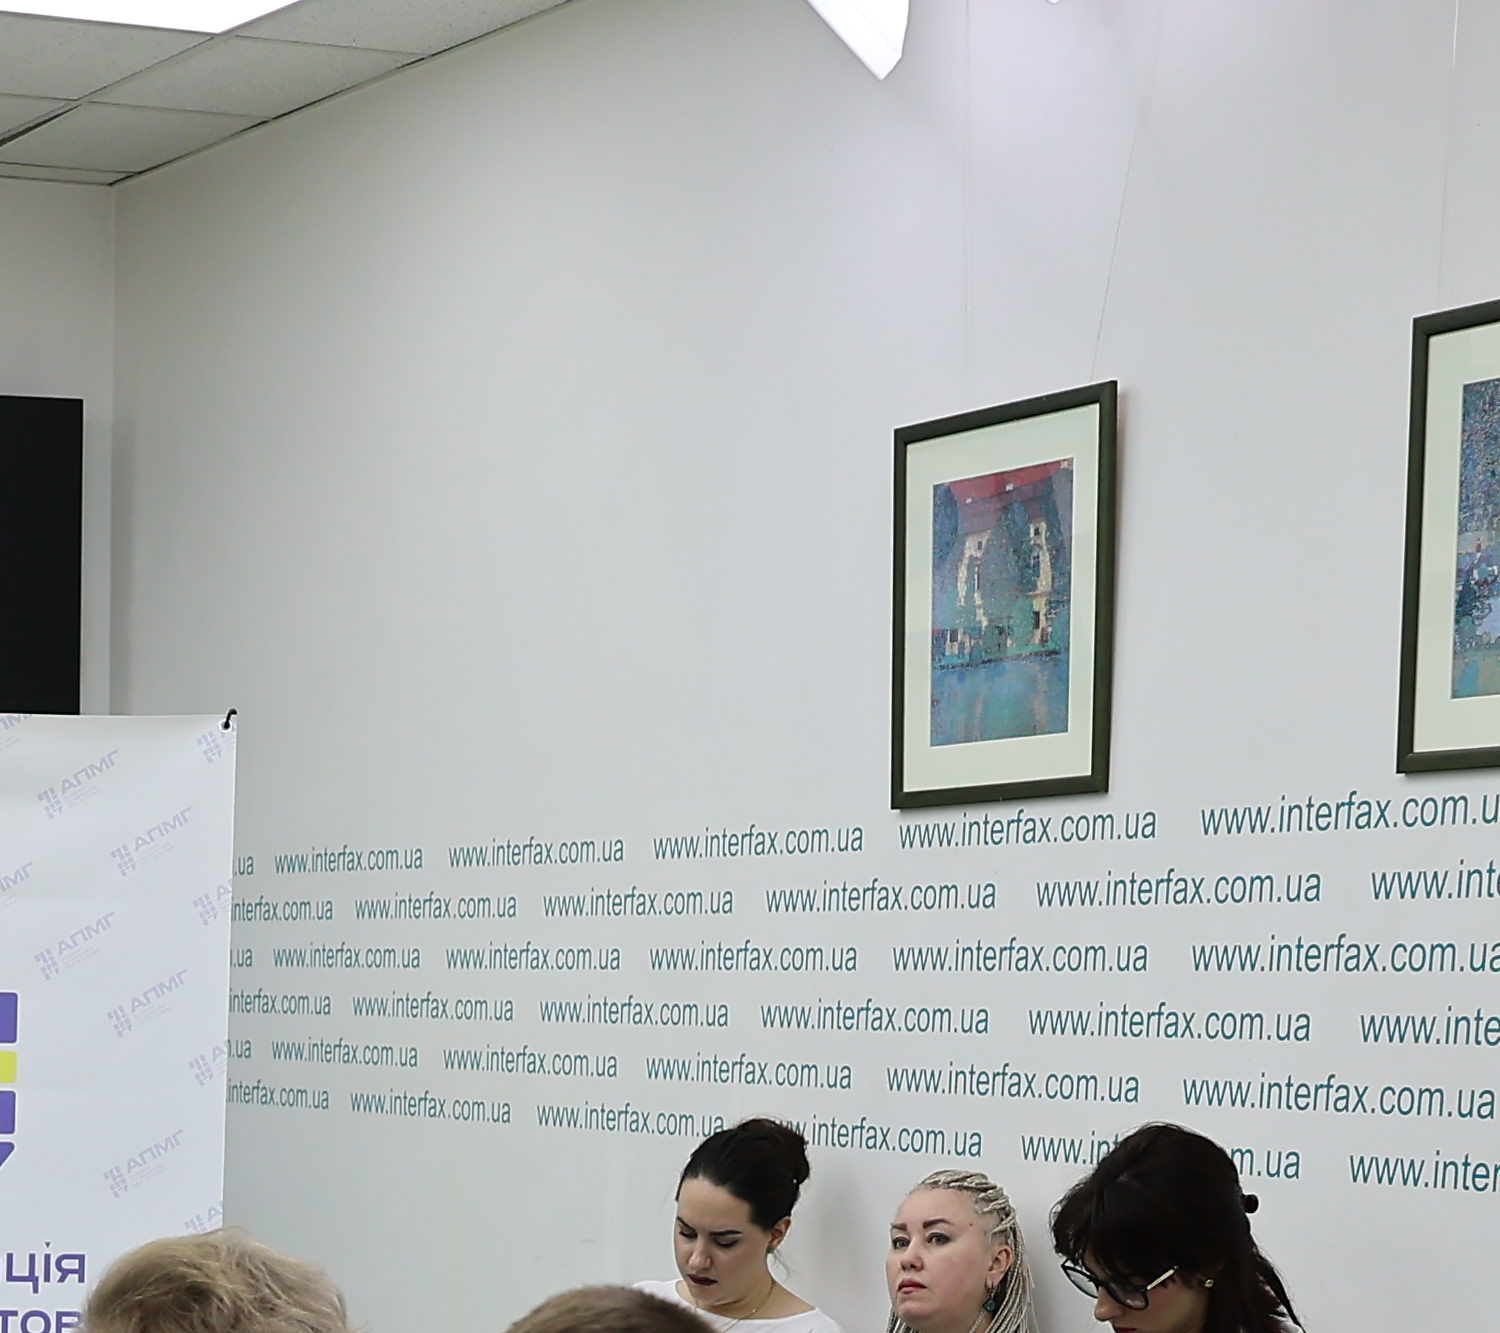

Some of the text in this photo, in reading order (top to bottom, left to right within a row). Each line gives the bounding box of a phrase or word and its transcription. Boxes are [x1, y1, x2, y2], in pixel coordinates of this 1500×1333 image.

[61, 750, 118, 794] АПМГ
[134, 806, 192, 852] АПМГ
[274, 844, 423, 874] www.interfax.com.ua
[449, 835, 623, 868] www.interfax.com.ua
[653, 824, 863, 860] www.interfax.com.ua
[899, 811, 1156, 850] www.interfax.com.ua
[231, 895, 333, 921] interfax.com.ua
[355, 890, 516, 920] www.interfax.com.ua
[543, 885, 733, 917] www.interfax.com.ua
[766, 877, 996, 914] www.interfax.com.ua
[1036, 868, 1321, 907] www.interfax.com.ua
[57, 912, 115, 955] АПМГ
[273, 941, 420, 969] www.interfax.com.ua
[446, 941, 620, 970] www.interfax.com.ua
[650, 939, 857, 972] www.interfax.com.ua
[893, 936, 1147, 972] www.interfax.com.ua
[130, 968, 187, 1013] АПМГ
[229, 988, 331, 1016] interfax.com.ua
[353, 990, 513, 1021] www.interfax.com.ua
[540, 994, 728, 1027] www.interfax.com.ua
[761, 996, 988, 1034] www.interfax.com.ua
[1029, 1001, 1310, 1042] www.interfax.com.ua
[272, 1036, 417, 1068] www.interfax.com.ua
[443, 1043, 617, 1078] www.interfax.com.ua
[646, 1051, 851, 1090] www.interfax.com.ua
[887, 1061, 1139, 1103] www.interfax.com.ua
[1183, 1072, 1495, 1119] www.interfax.com.ua
[350, 1088, 511, 1124] www.interfax.com.ua
[537, 1100, 725, 1137] www.interfax.com.ua
[127, 1129, 183, 1173] АПМГ
